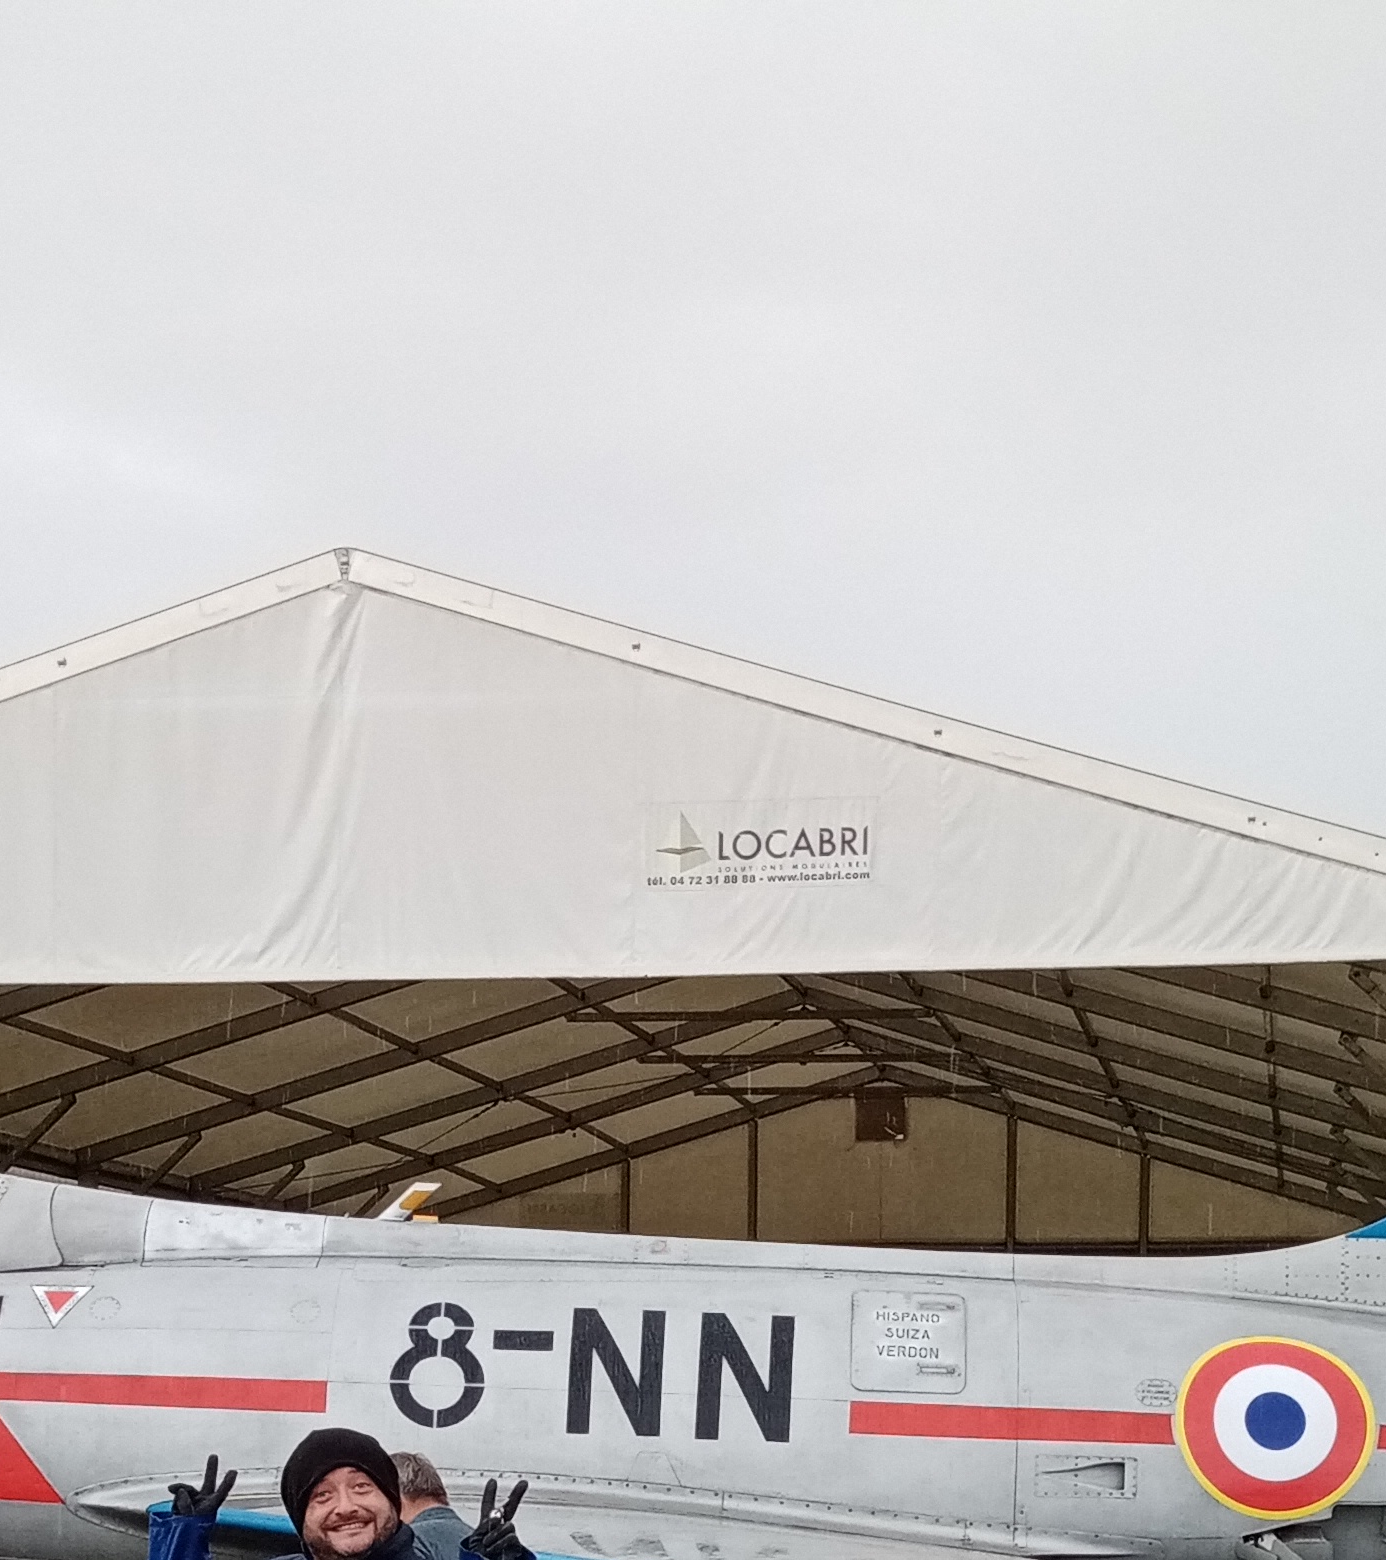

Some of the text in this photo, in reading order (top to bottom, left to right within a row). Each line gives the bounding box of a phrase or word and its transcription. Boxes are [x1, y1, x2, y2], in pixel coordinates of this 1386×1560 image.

[718, 825, 869, 861] LOCABRI
[670, 876, 684, 886] 04
[688, 876, 703, 885] 72
[705, 875, 719, 885] 31
[767, 870, 871, 883] www.locabri.com
[875, 1311, 940, 1323] HISPANO
[884, 1327, 931, 1340] SUIZA
[876, 1345, 940, 1359] VERDON
[389, 1301, 795, 1443] 8-NN
